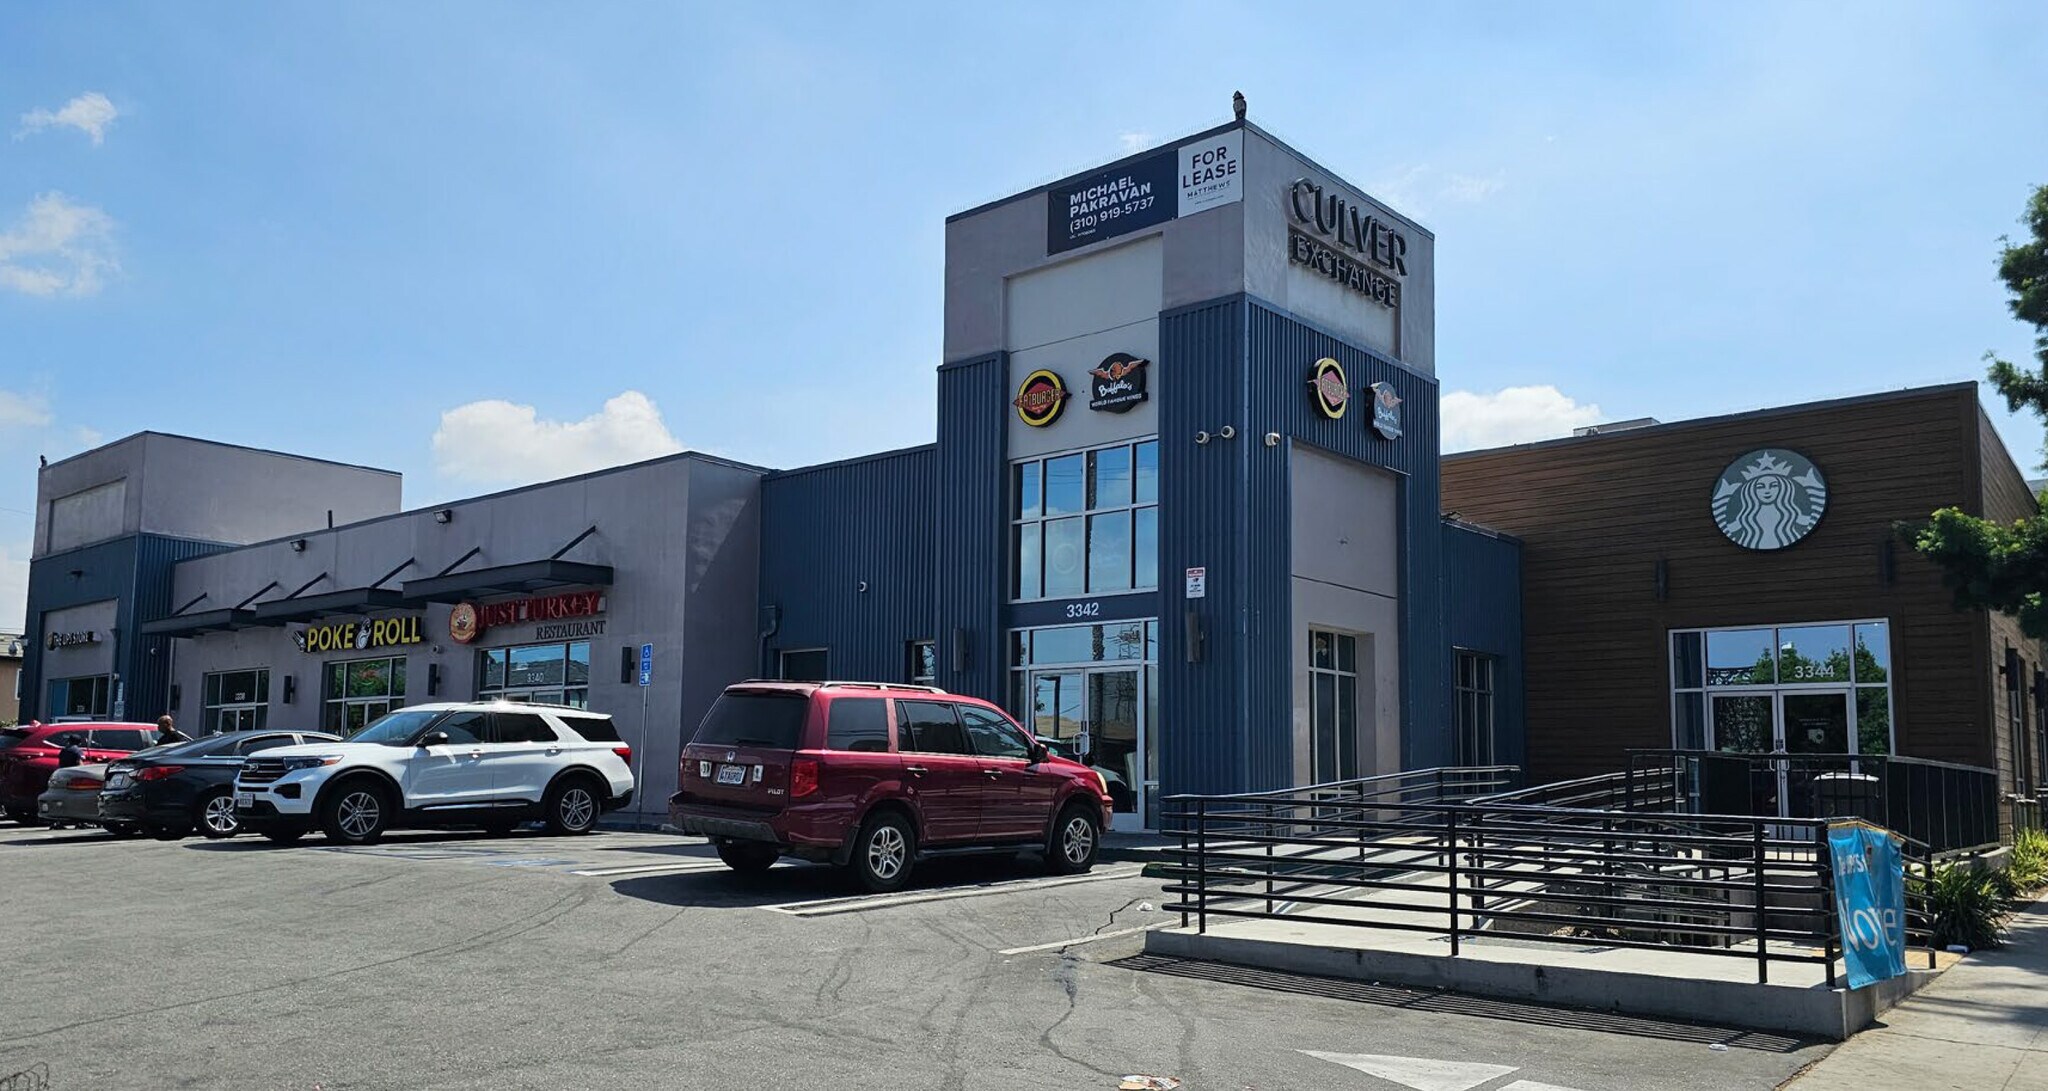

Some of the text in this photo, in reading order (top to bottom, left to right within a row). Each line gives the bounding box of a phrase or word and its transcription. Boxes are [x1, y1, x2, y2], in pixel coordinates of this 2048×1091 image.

[1192, 146, 1227, 169] FOR
[1183, 160, 1237, 189] LEASE
[1187, 180, 1231, 198] MATTHEWS
[1070, 175, 1135, 206] MICHAEL
[1070, 182, 1151, 218] PAKRAVAN
[1069, 214, 1097, 234] (310)
[1101, 196, 1155, 222] 919-5737
[1290, 178, 1407, 276] CULVER
[1291, 234, 1398, 308] EXCHANGE
[478, 602, 517, 628] JUST
[521, 593, 600, 621] TURKEY
[1066, 602, 1099, 618] 3342
[308, 623, 355, 652] POKE
[373, 616, 421, 647] ROLL
[536, 620, 607, 641] RESTAURANT
[527, 672, 545, 683] 3340
[1794, 665, 1836, 679] 3344
